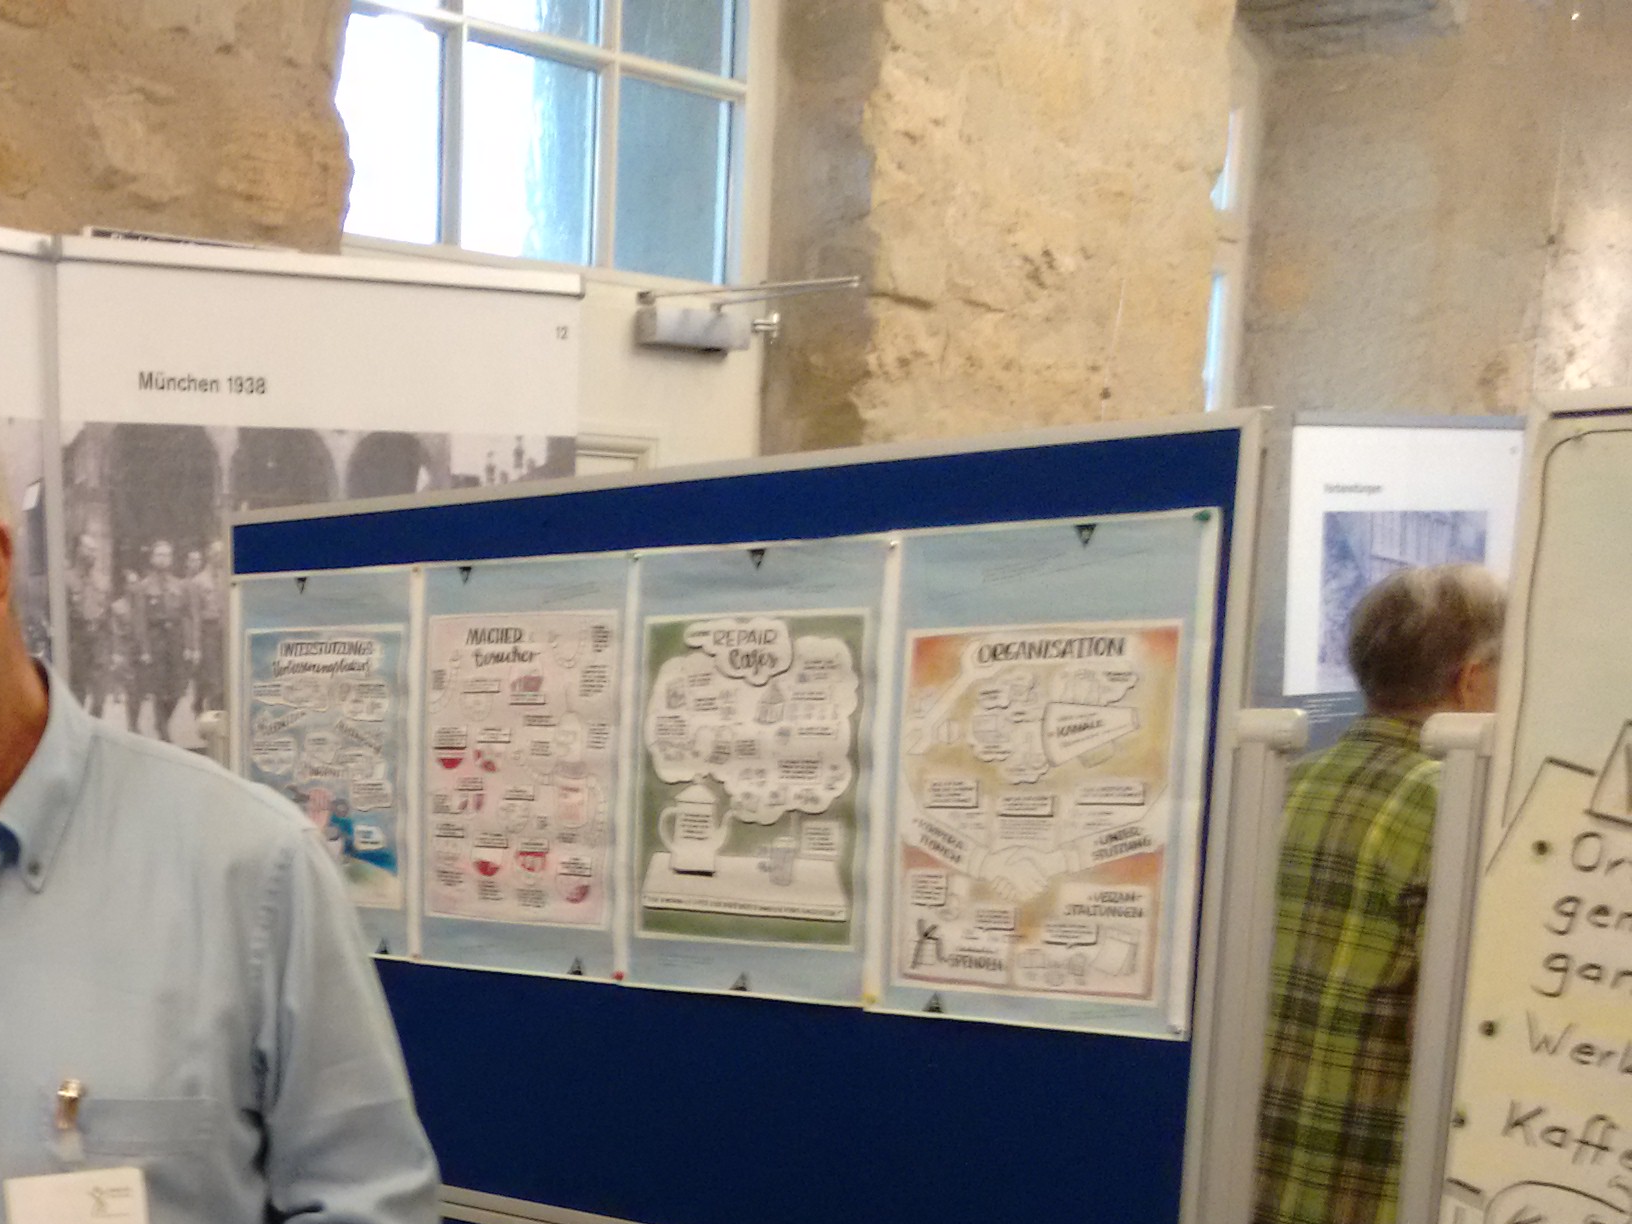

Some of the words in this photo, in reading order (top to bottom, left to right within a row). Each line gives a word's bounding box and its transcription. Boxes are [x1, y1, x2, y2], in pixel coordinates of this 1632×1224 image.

[138, 370, 220, 394] München
[227, 375, 267, 395] 1938
[712, 629, 778, 647] REPAIR
[977, 636, 1126, 664] ORGANISATION
